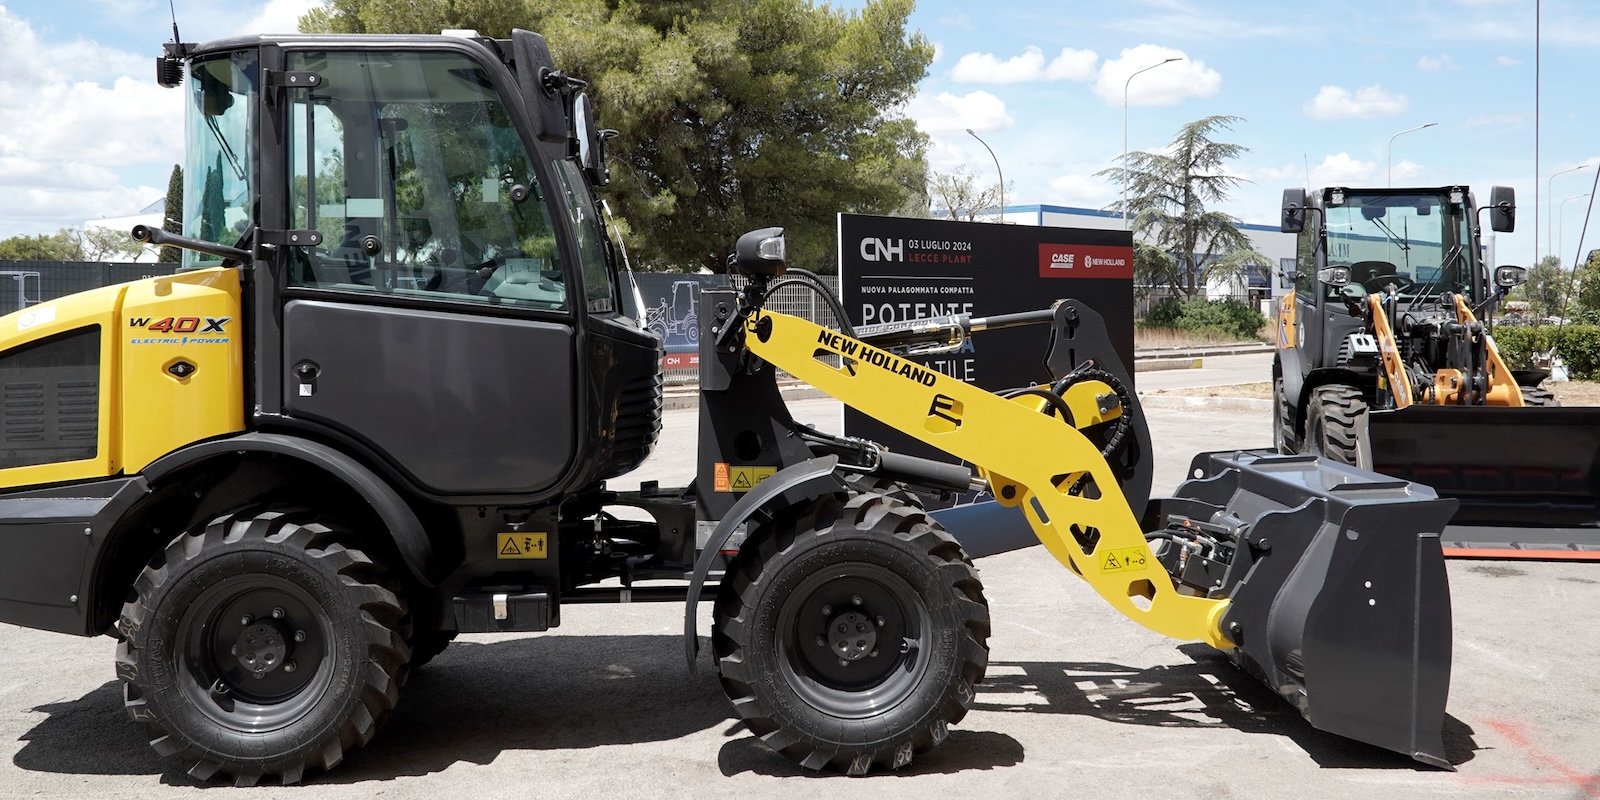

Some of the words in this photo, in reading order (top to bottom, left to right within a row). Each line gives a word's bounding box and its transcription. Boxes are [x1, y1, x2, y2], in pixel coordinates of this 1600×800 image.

[860, 237, 904, 262] CNH
[909, 240, 919, 250] 03
[921, 240, 951, 251] LUGLIO
[953, 241, 972, 251] 2024
[909, 253, 939, 263] LECCE
[943, 254, 971, 264] PLANT
[1051, 253, 1075, 263] CASE
[1092, 258, 1104, 266] NEW
[861, 286, 886, 294] NUOVA
[888, 286, 939, 294] PALAGOMMATA
[940, 286, 974, 294] COMPATTA
[863, 303, 974, 325] POTENTE
[130, 317, 232, 333] W40X
[817, 330, 859, 354] NEW
[859, 346, 937, 387] HOLLAND
